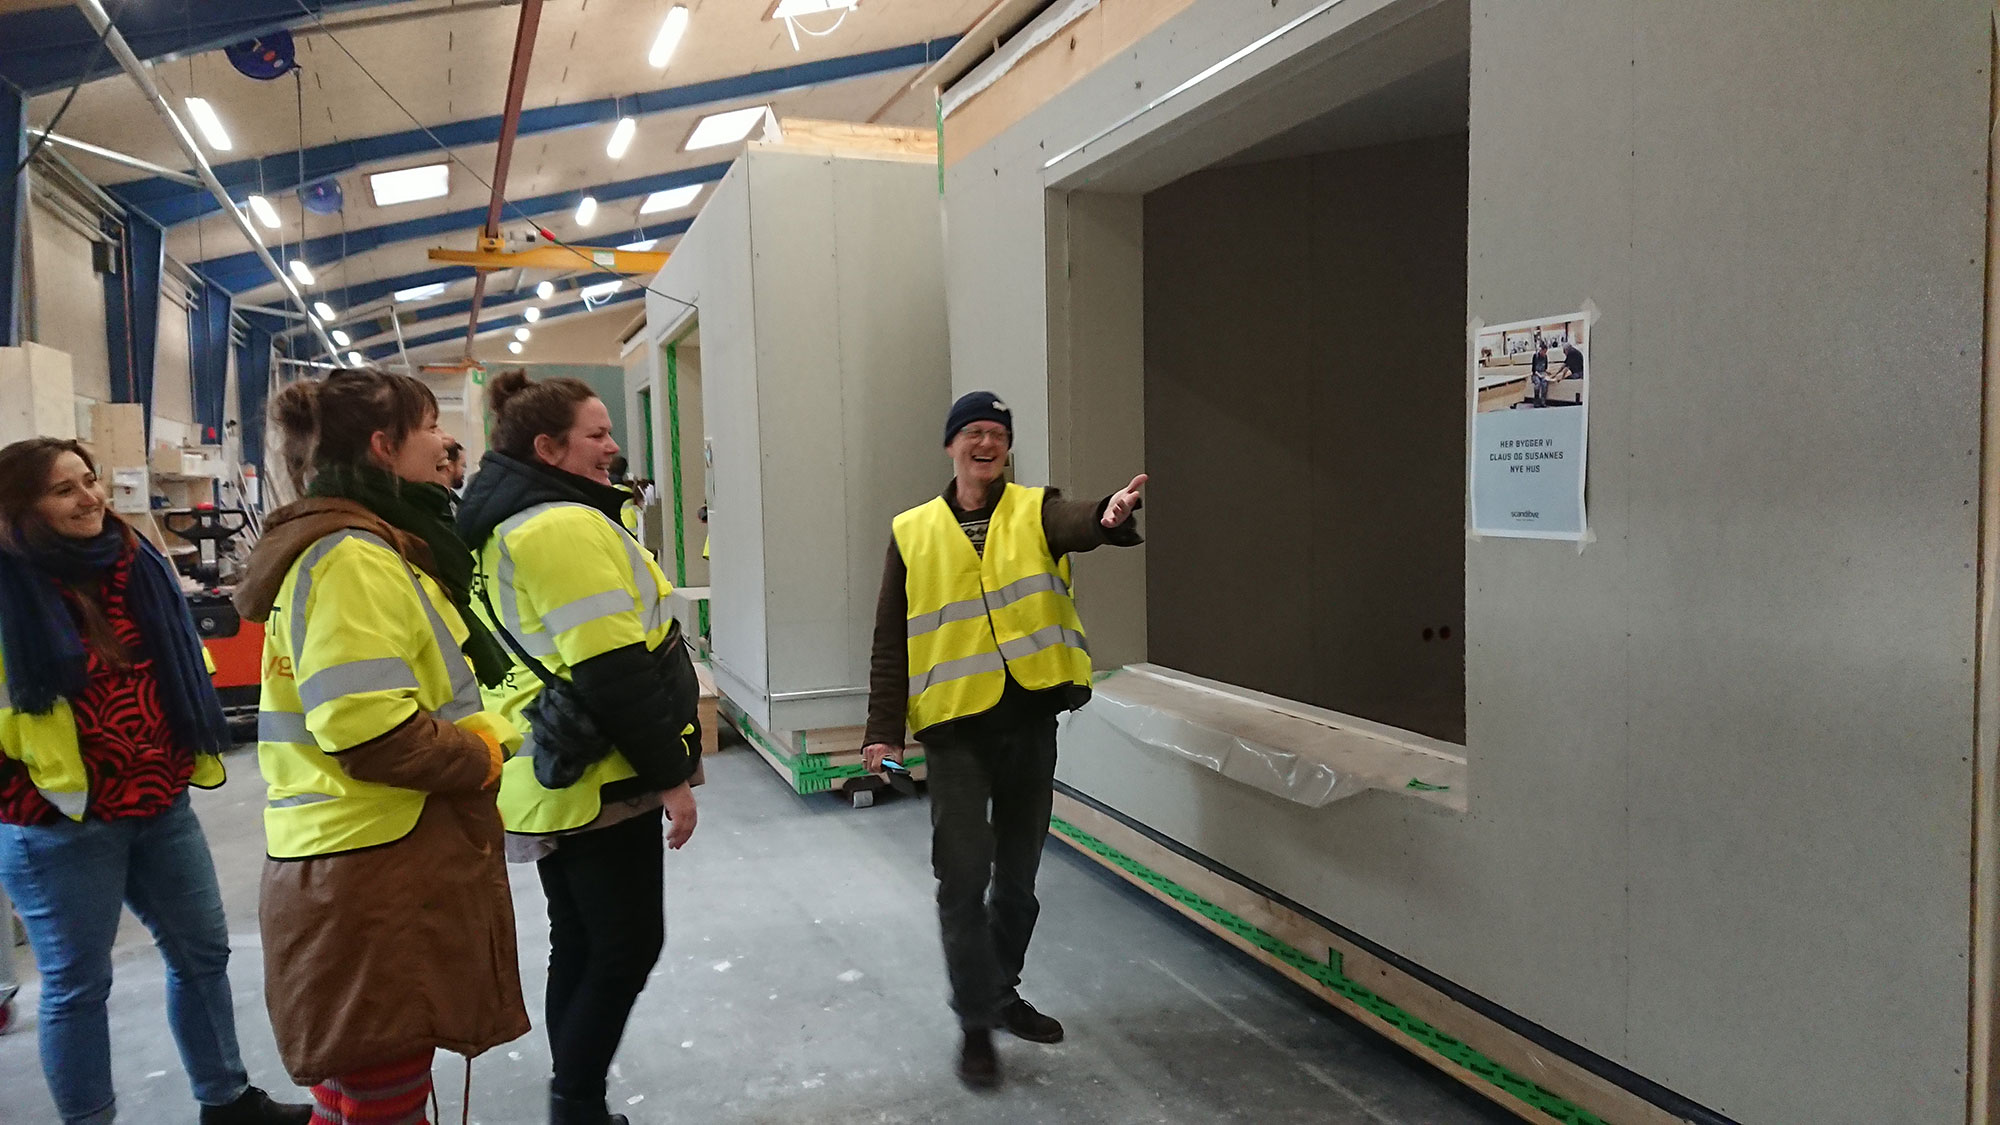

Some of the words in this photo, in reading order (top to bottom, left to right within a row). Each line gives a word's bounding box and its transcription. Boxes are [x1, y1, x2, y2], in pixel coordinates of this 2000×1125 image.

[1500, 440, 1514, 448] HER
[1516, 439, 1544, 448] BYGGER
[1546, 438, 1553, 447] VI
[1489, 453, 1512, 461] CLAUS
[1514, 452, 1523, 461] OG
[1525, 451, 1564, 460] SUSANNES
[1510, 465, 1524, 473] NYE
[1526, 465, 1541, 473] HUS
